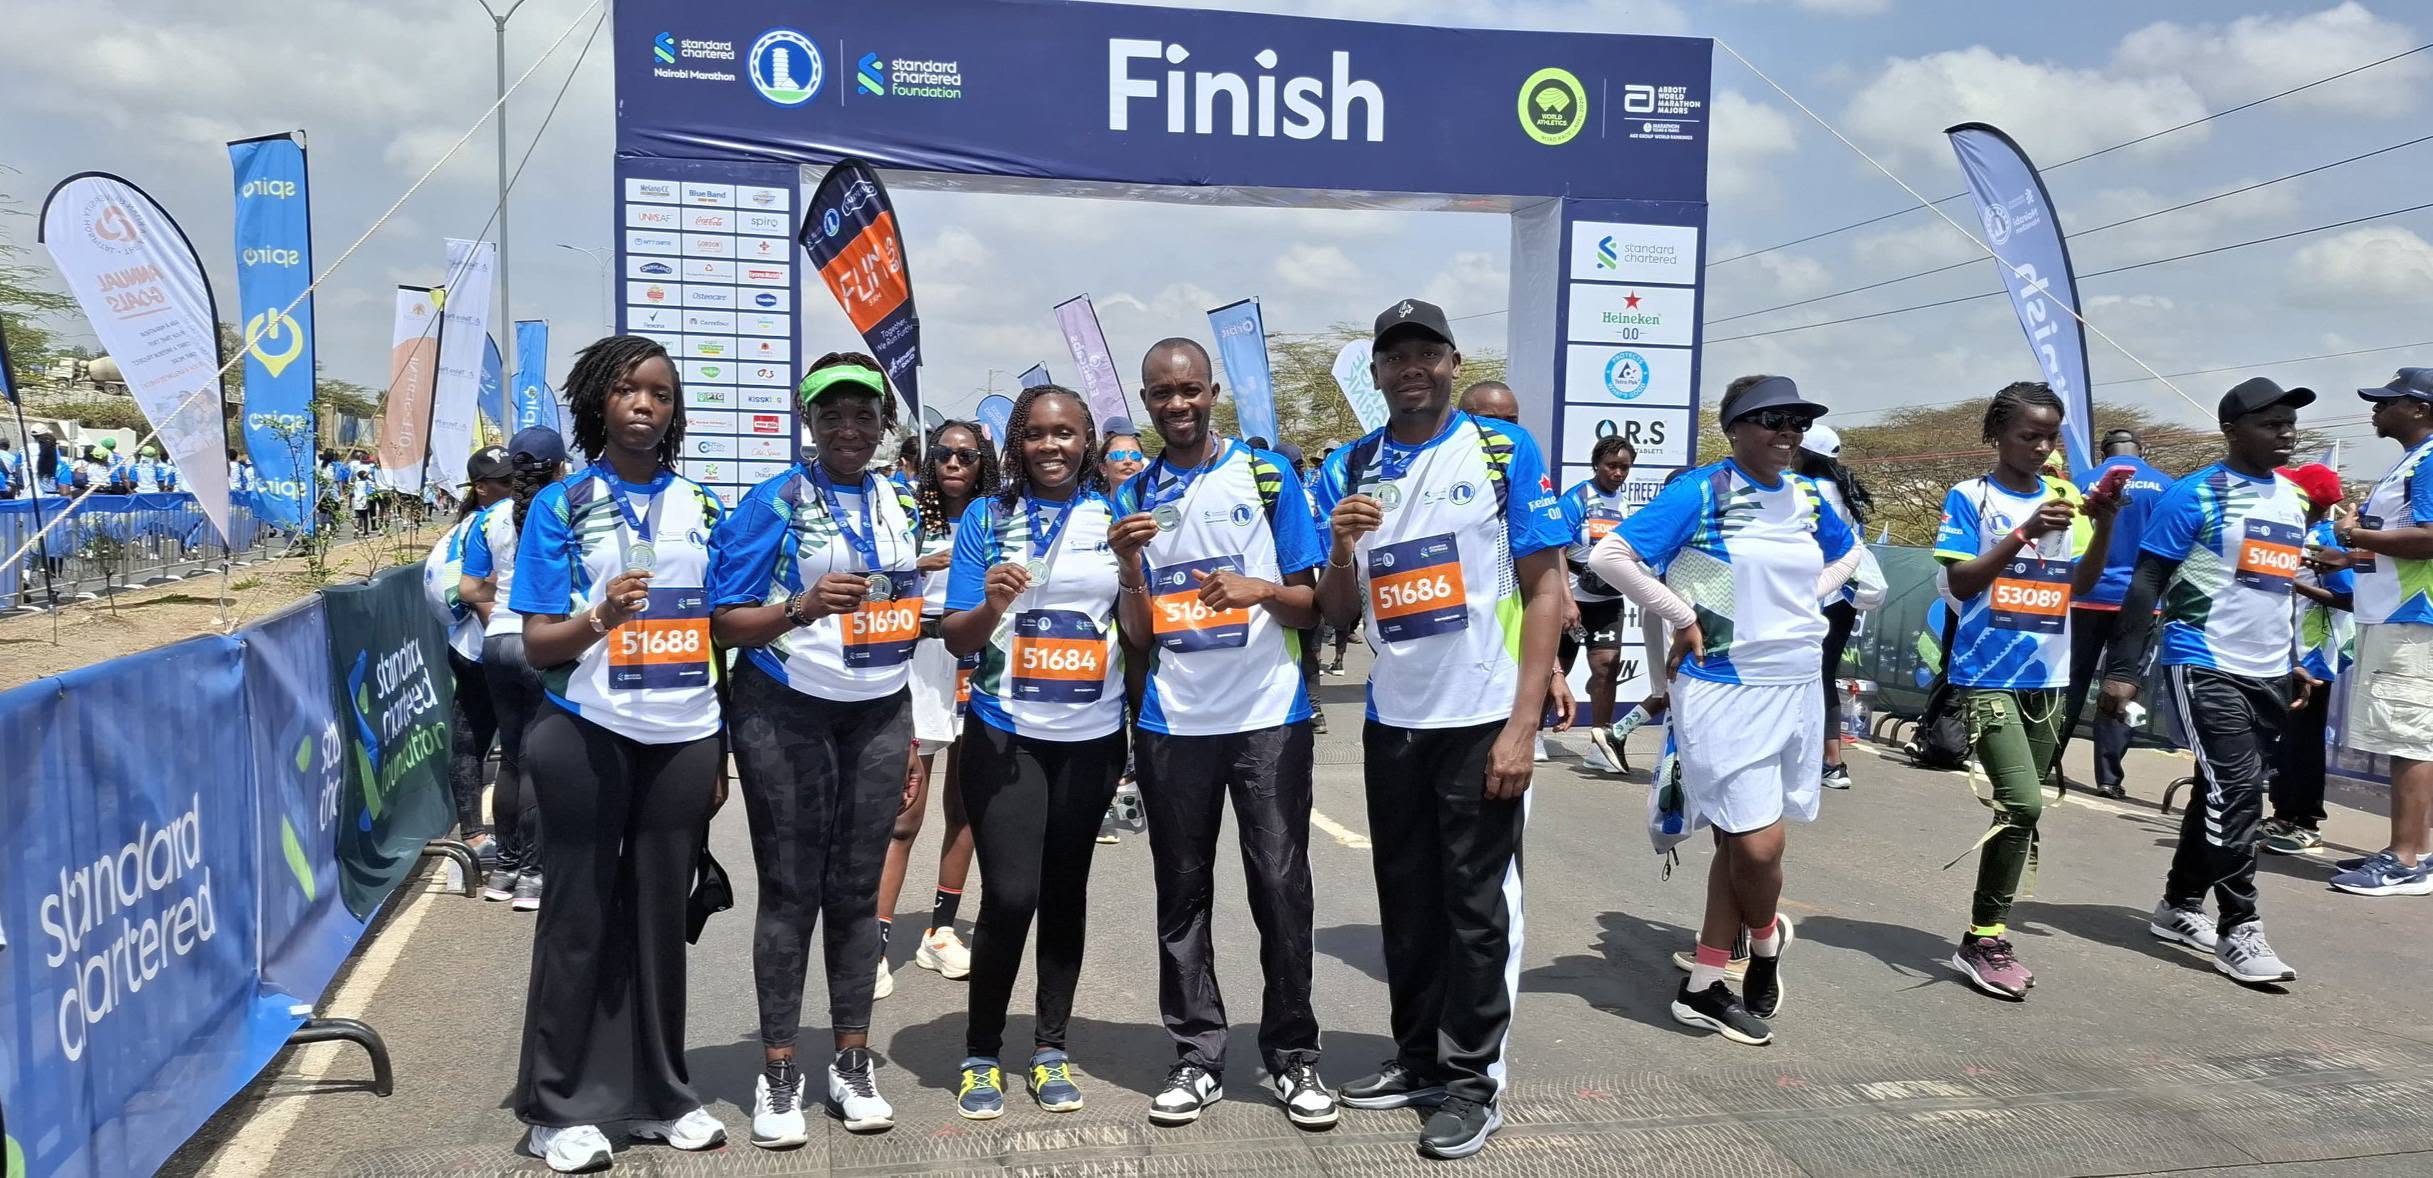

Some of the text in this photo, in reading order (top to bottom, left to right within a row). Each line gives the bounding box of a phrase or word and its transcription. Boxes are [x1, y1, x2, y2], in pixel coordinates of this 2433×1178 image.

[681, 38, 731, 50] standard
[681, 48, 735, 60] chartered
[892, 58, 957, 74] standard
[654, 68, 735, 82] Nairobi Marathon
[892, 71, 961, 86] chartered
[892, 83, 961, 99] foundation
[1109, 38, 1384, 142] Finish
[1658, 86, 1687, 94] ABBOTT
[1658, 93, 1685, 101] WORLD
[1658, 100, 1701, 108] MARATHON
[689, 189, 726, 199] Blue Band
[751, 217, 778, 228] spiro
[1624, 243, 1674, 255] standard
[1624, 253, 1677, 265] chartered
[1603, 311, 1661, 325] Heineken
[1379, 575, 1451, 609] 51686
[1996, 587, 2062, 610] 53089
[851, 607, 914, 635] 51690
[621, 630, 700, 655] 51688
[1023, 648, 1096, 671] 51684
[40, 791, 200, 967] standard
